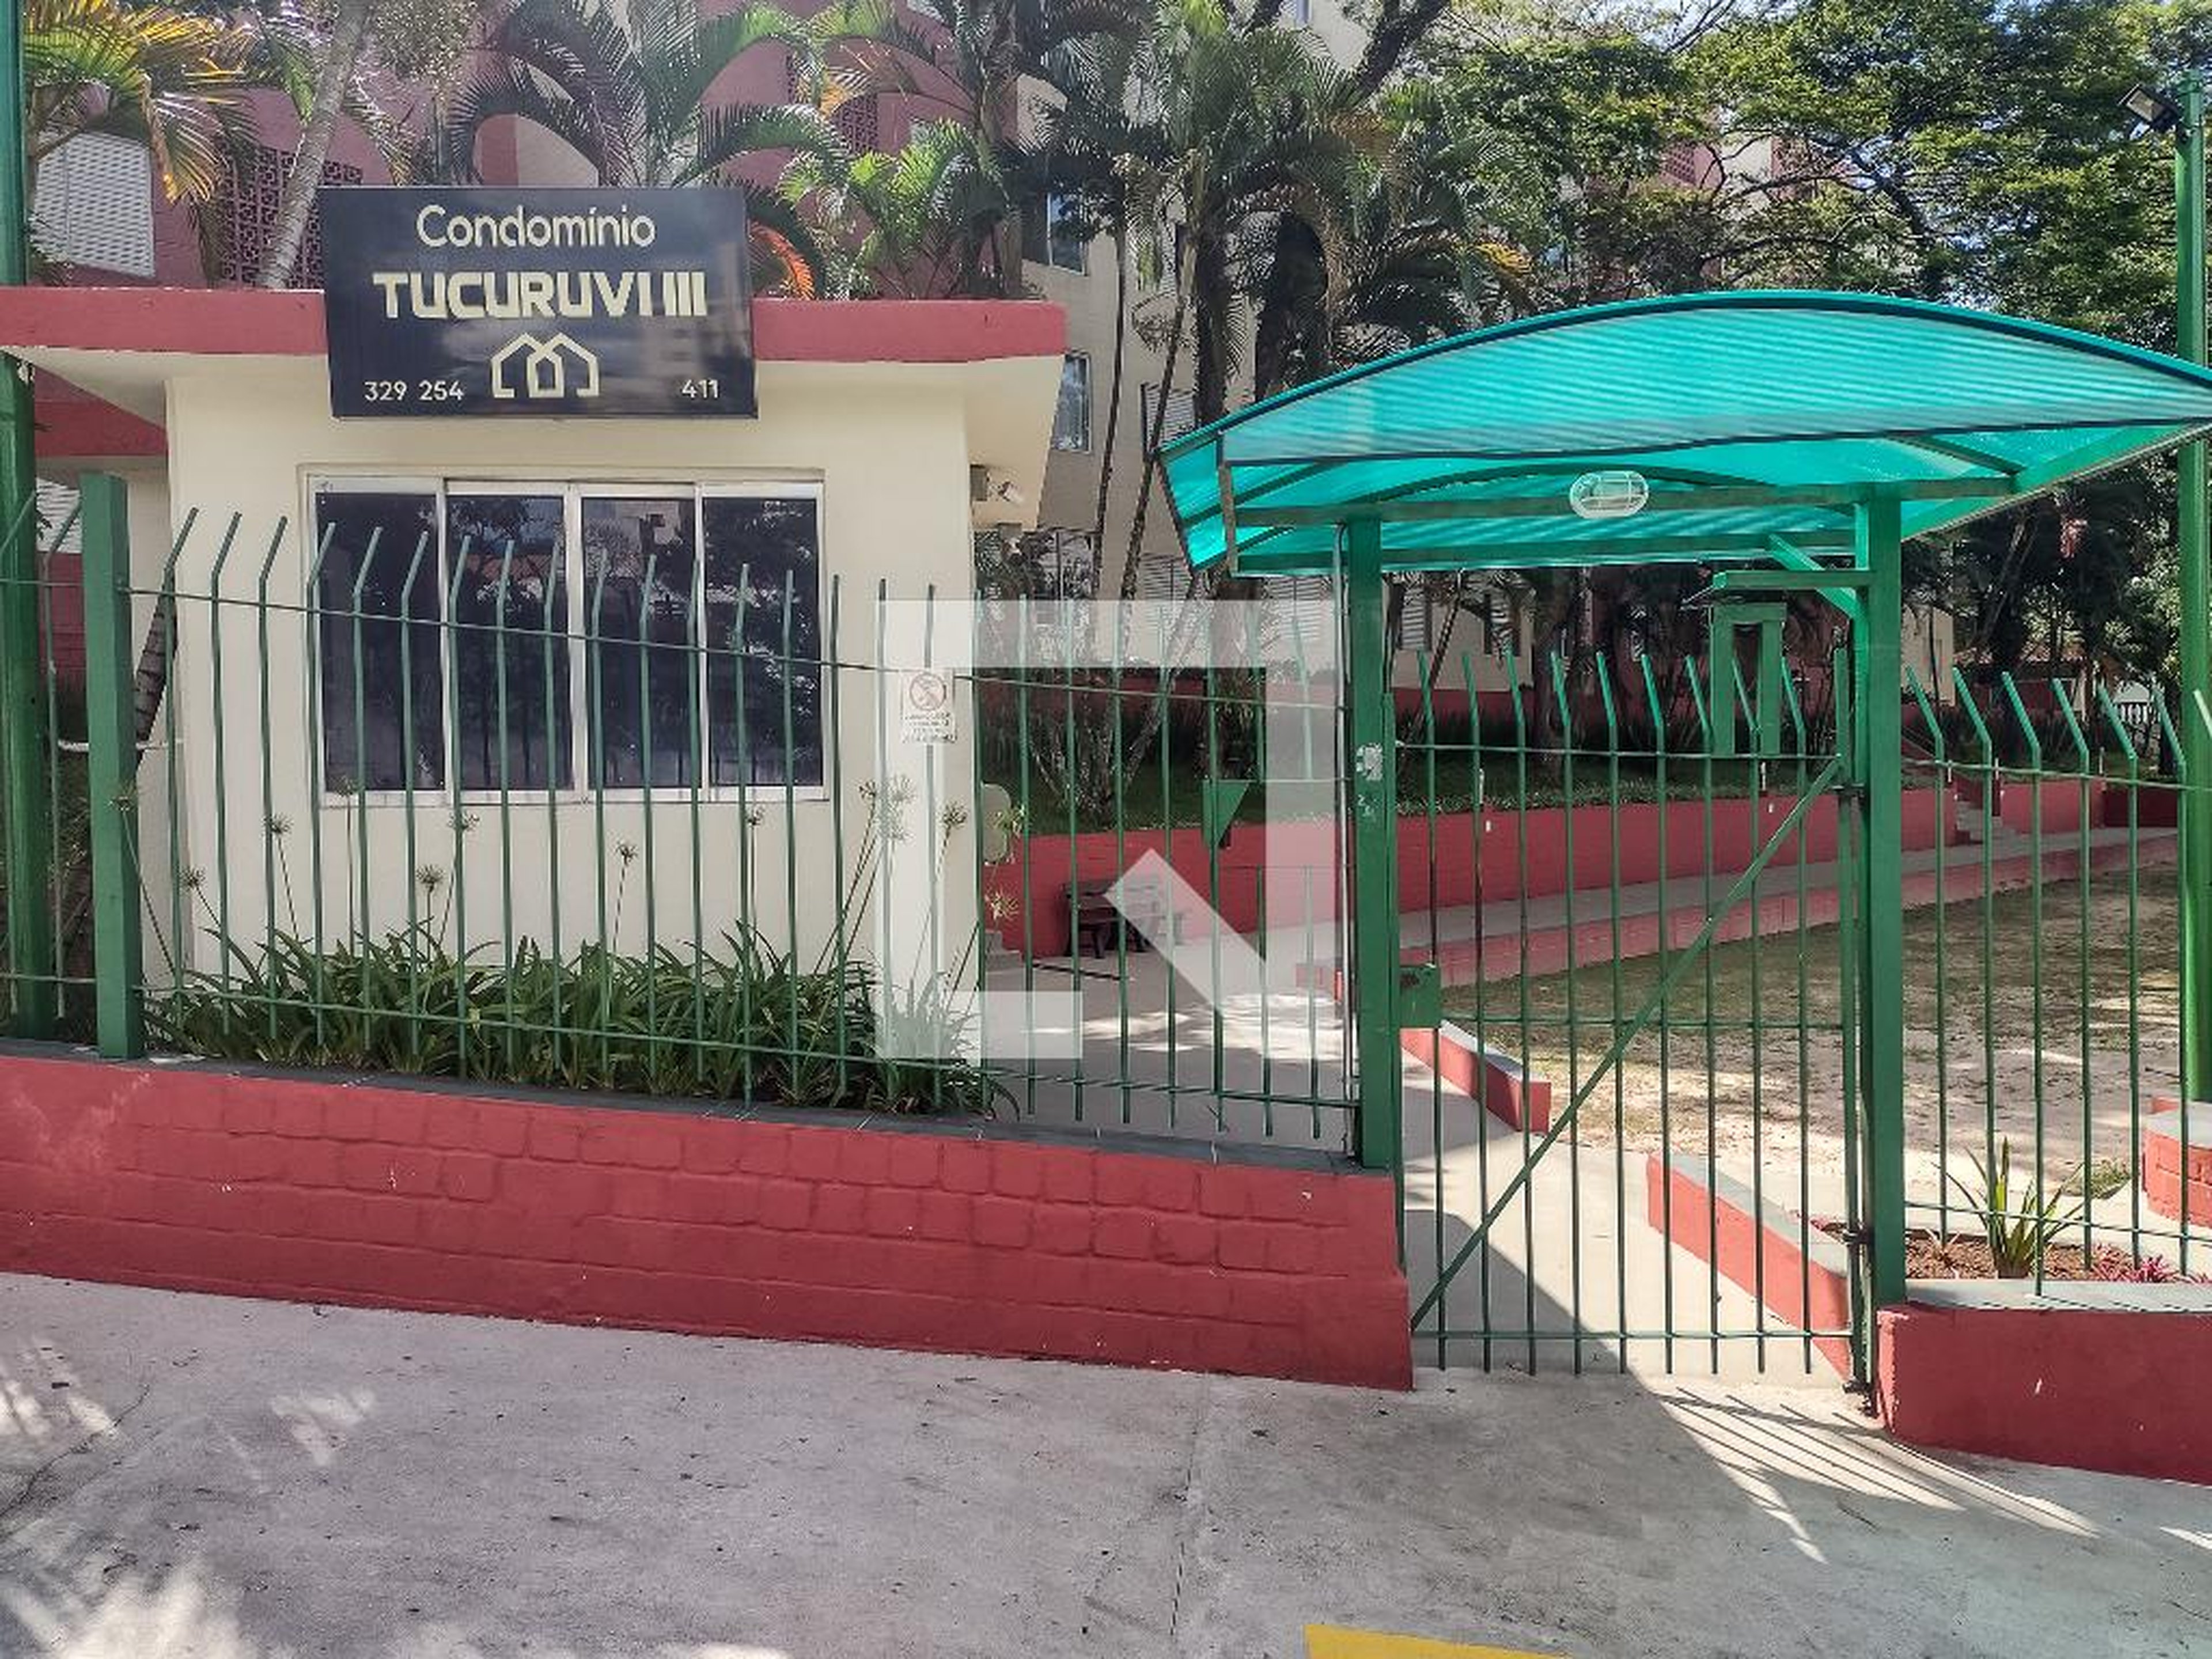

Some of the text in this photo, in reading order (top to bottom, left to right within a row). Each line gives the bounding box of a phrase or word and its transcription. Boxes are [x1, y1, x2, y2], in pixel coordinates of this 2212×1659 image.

[416, 204, 656, 247] Condomínio
[373, 272, 708, 319] TUCURUVI III
[364, 381, 464, 402] 329 254
[682, 379, 719, 398] 411
